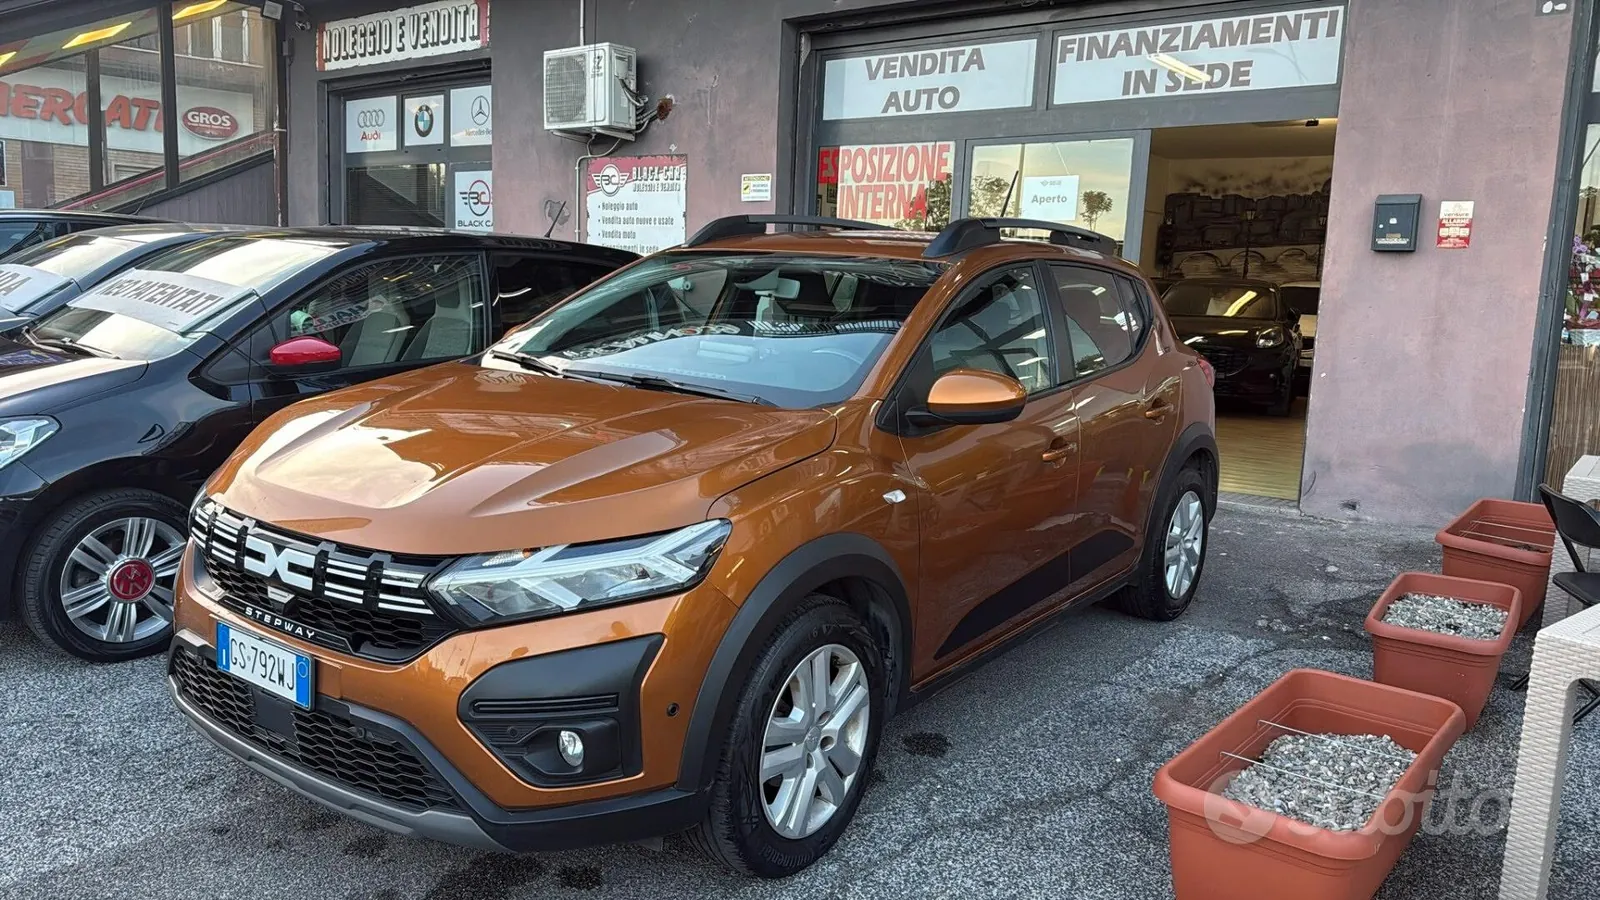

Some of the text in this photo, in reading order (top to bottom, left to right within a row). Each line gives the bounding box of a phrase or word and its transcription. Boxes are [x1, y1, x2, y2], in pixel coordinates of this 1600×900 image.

[322, 3, 480, 62] NOLEGGIO E VENDITA
[1058, 10, 1339, 63] FINANZIAMENTI
[865, 48, 985, 80] VENDITA
[1122, 60, 1253, 96] IN SEDE
[881, 86, 960, 113] AUTO
[187, 111, 231, 127] GROS
[360, 130, 381, 141] Audi
[632, 166, 660, 181] BLACK
[817, 144, 950, 184] ESPOSIZIONE
[602, 202, 638, 211] Noleggio auto
[840, 183, 927, 219] INTERNA
[1031, 194, 1067, 205] Aperto
[602, 215, 621, 225] Vendita
[623, 217, 635, 225] auto
[636, 217, 652, 225] nuove
[658, 217, 674, 225] usate
[602, 230, 636, 239] Vendita moto
[121, 279, 224, 315] PATENTATI
[245, 606, 315, 638] STEPWAY
